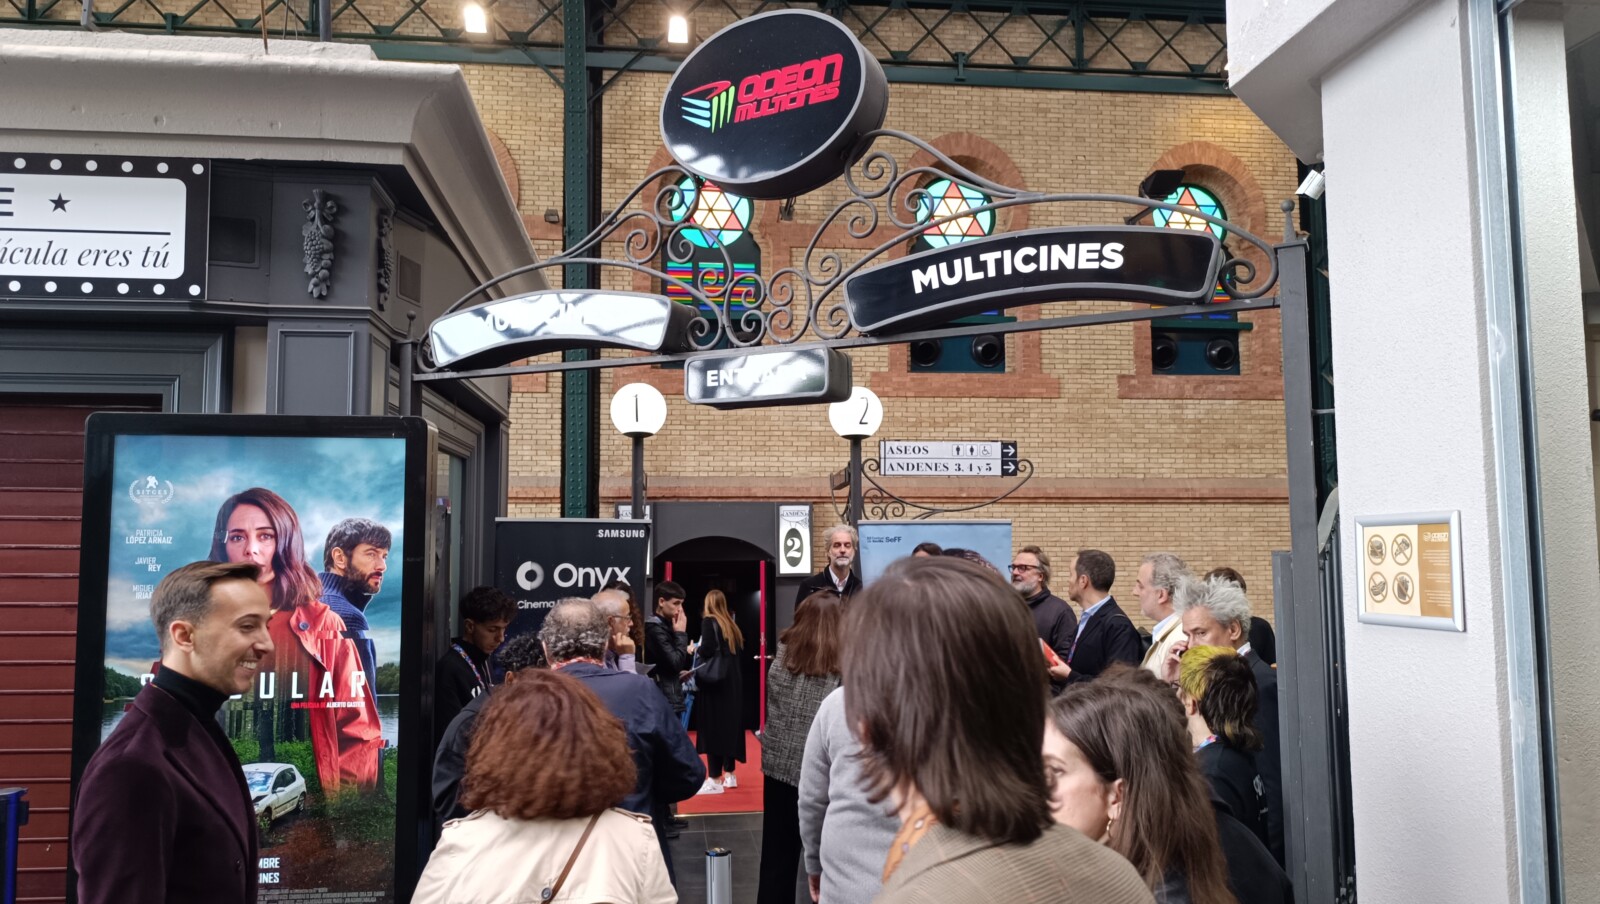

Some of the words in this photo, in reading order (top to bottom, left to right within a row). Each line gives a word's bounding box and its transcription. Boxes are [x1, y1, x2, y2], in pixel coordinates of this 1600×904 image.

[737, 53, 844, 104] ODEON
[734, 81, 840, 123] MULTICINES
[77, 248, 132, 267] eres
[141, 242, 170, 269] tú
[911, 242, 1125, 294] MULTICINES
[632, 393, 639, 423] 1
[858, 396, 870, 425] 2
[886, 445, 929, 455] ASEOS
[886, 462, 949, 472] ANDENES
[976, 465, 984, 475] y
[985, 462, 992, 472] 5
[135, 529, 163, 537] PATRICIA
[598, 529, 645, 538] SAMSUNG
[125, 535, 147, 545] LÓPEZ
[147, 536, 173, 545] ARNAIZ
[786, 537, 802, 558] 2
[134, 556, 157, 565] JAVIER
[147, 564, 162, 572] REY
[553, 562, 631, 593] Onyx
[132, 584, 155, 593] MIGUEL
[517, 599, 555, 610] Cinema
